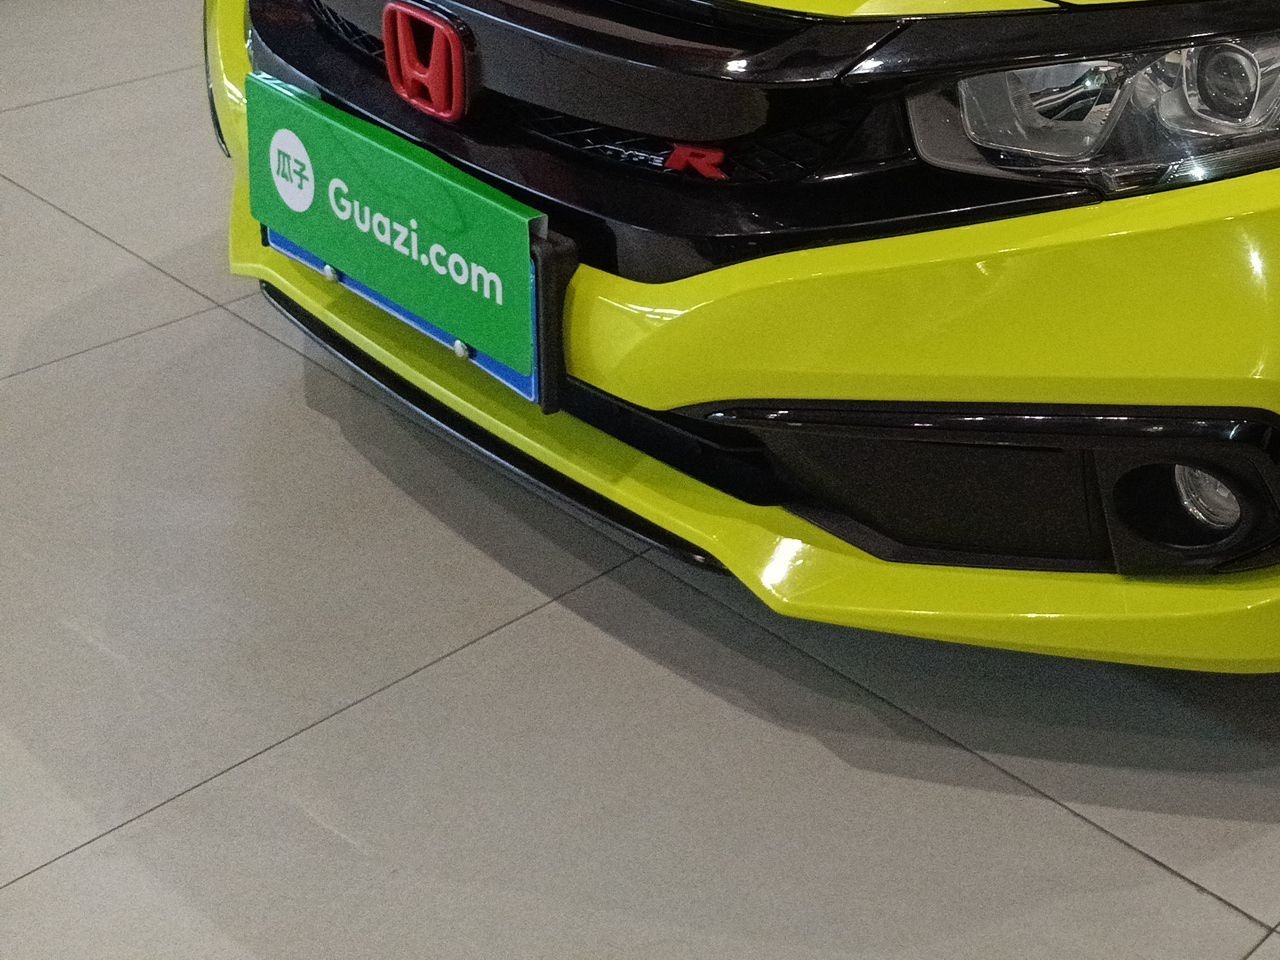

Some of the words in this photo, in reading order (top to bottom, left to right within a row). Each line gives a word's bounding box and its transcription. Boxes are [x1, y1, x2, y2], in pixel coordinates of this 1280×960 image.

[276, 149, 310, 190] 瓜子
[664, 143, 730, 180] R
[328, 177, 503, 305] Guazi.com
